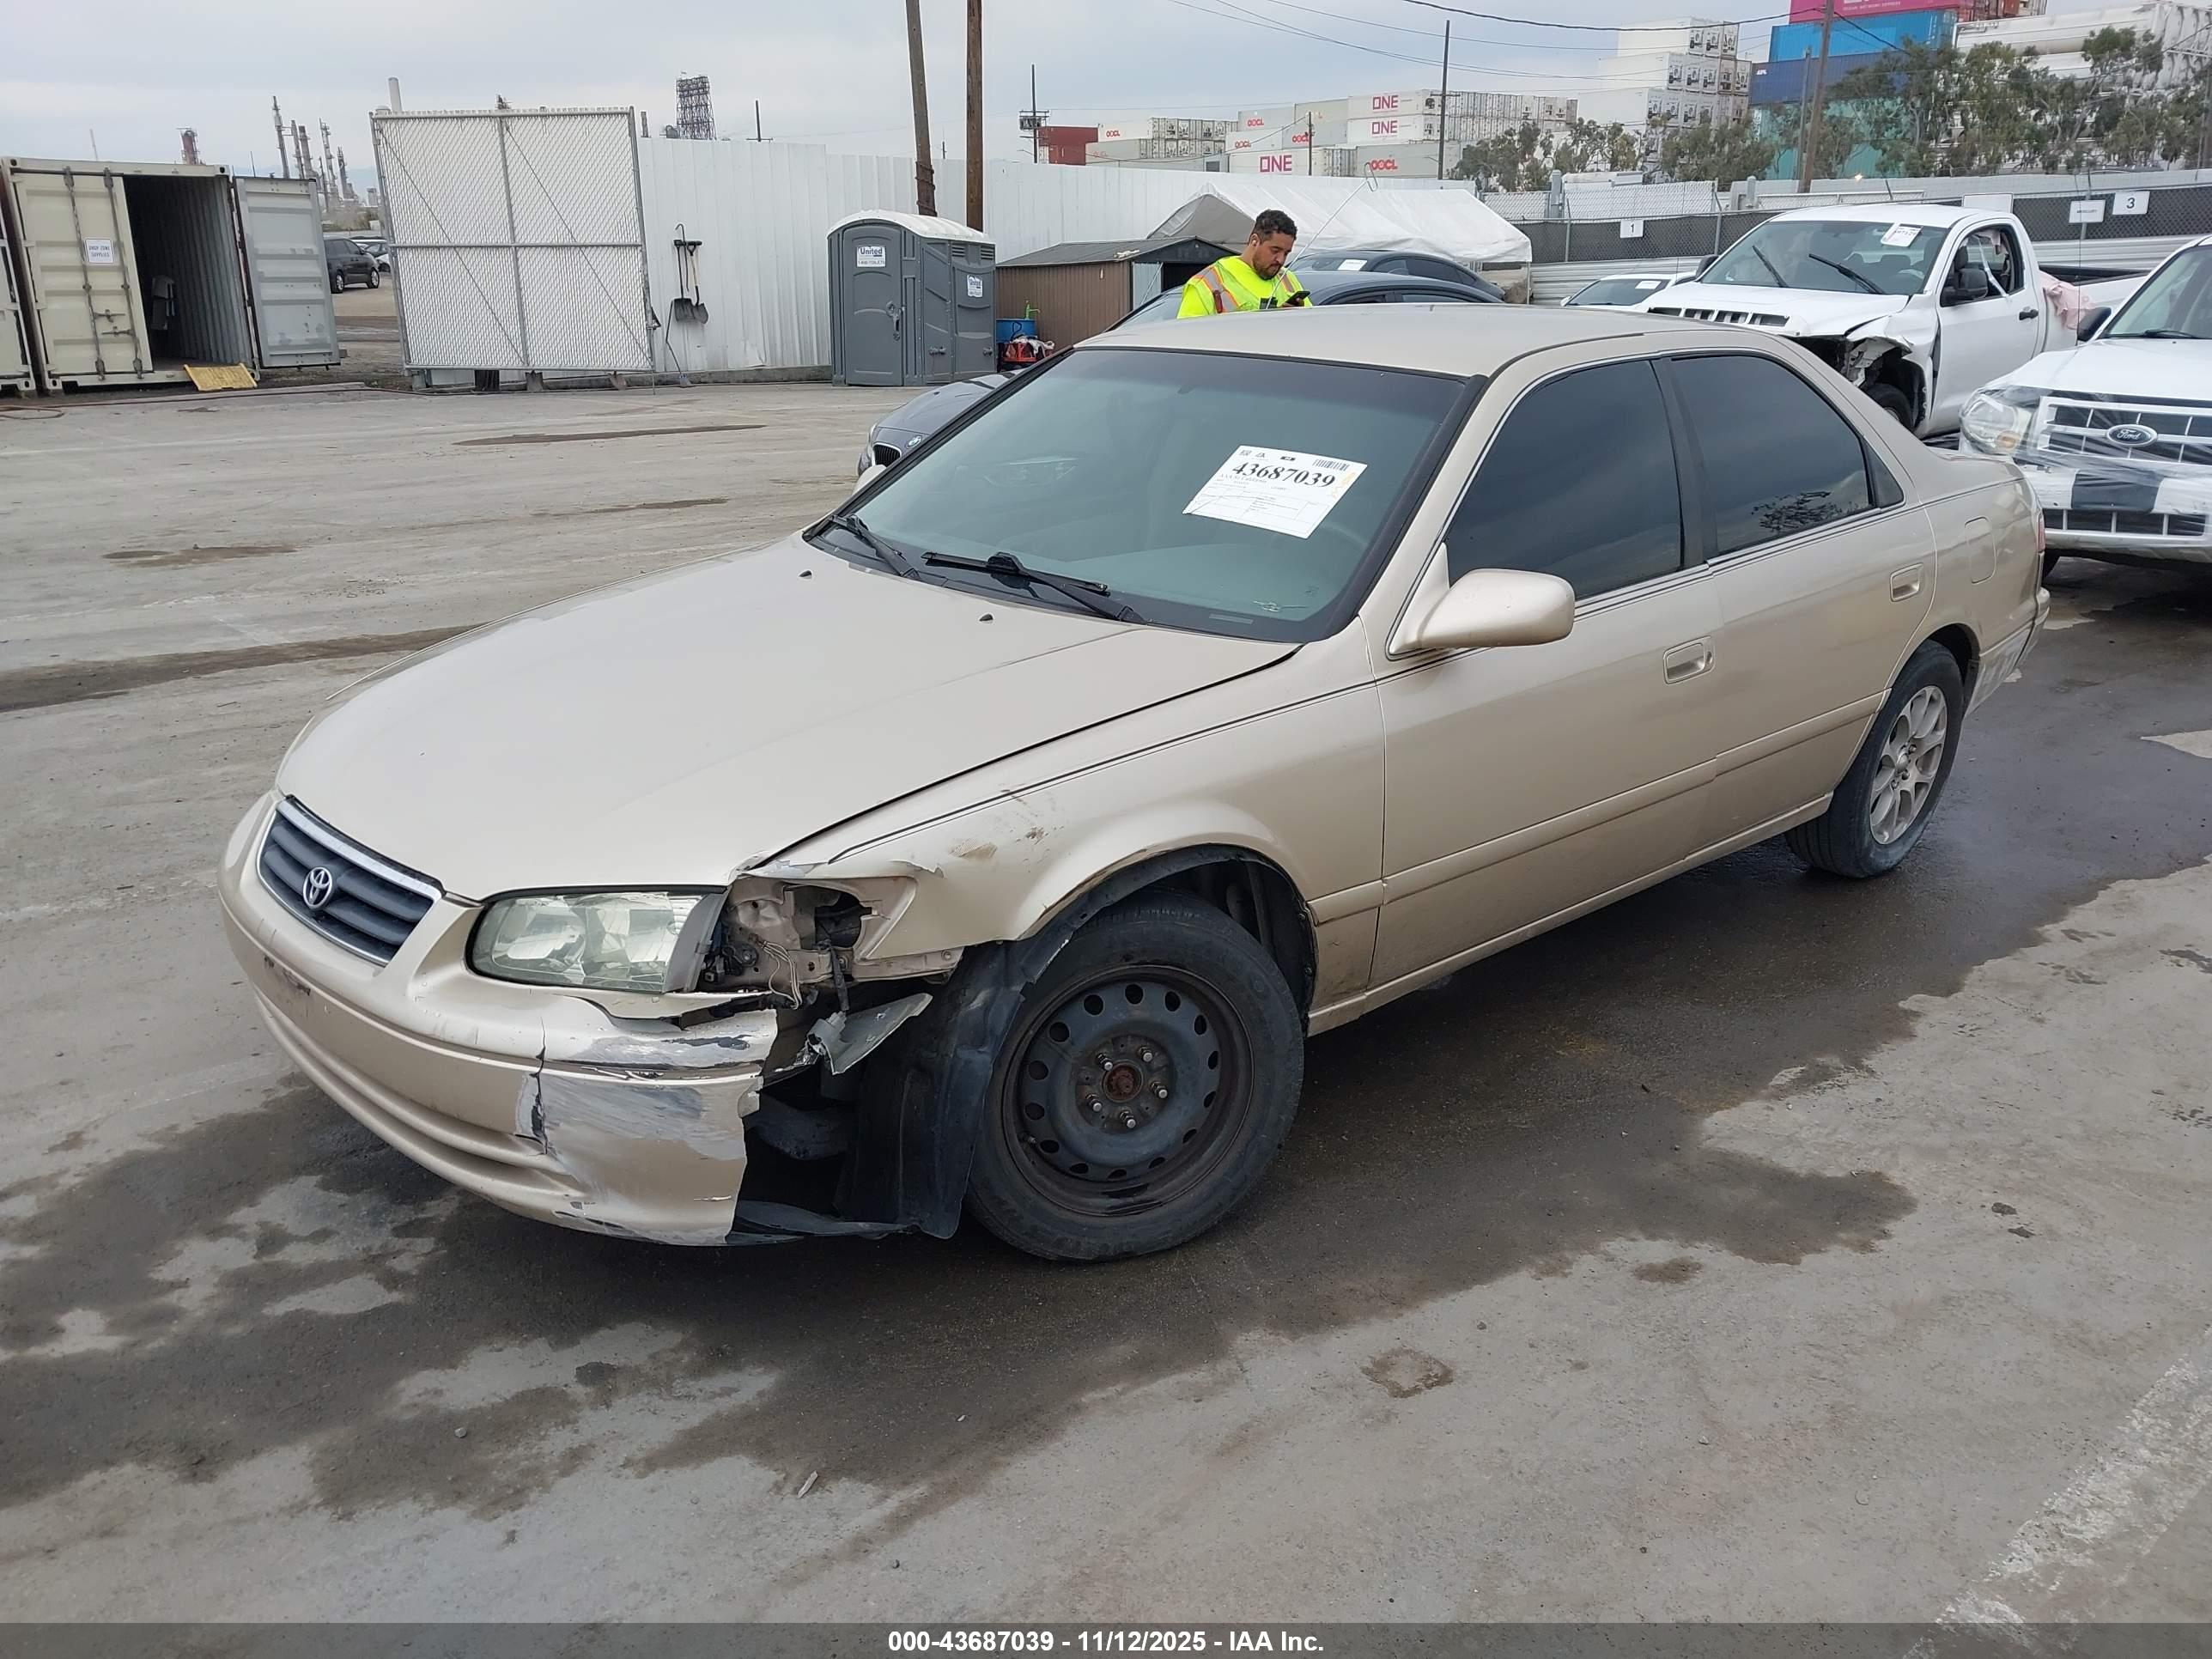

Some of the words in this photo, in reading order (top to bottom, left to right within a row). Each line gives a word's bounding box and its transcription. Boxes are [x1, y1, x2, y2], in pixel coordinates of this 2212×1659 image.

[1372, 94, 1399, 110] ONE
[1247, 118, 1264, 127] OOCL
[1371, 120, 1398, 134] ONE
[1235, 141, 1251, 149] OOCL
[1260, 155, 1292, 173] ONE
[1370, 159, 1398, 171] OOCL
[2125, 197, 2136, 209] 3
[1630, 222, 1635, 234] 1
[860, 246, 883, 255] United
[2116, 428, 2142, 440] Ford
[1232, 462, 1336, 488] 43687039
